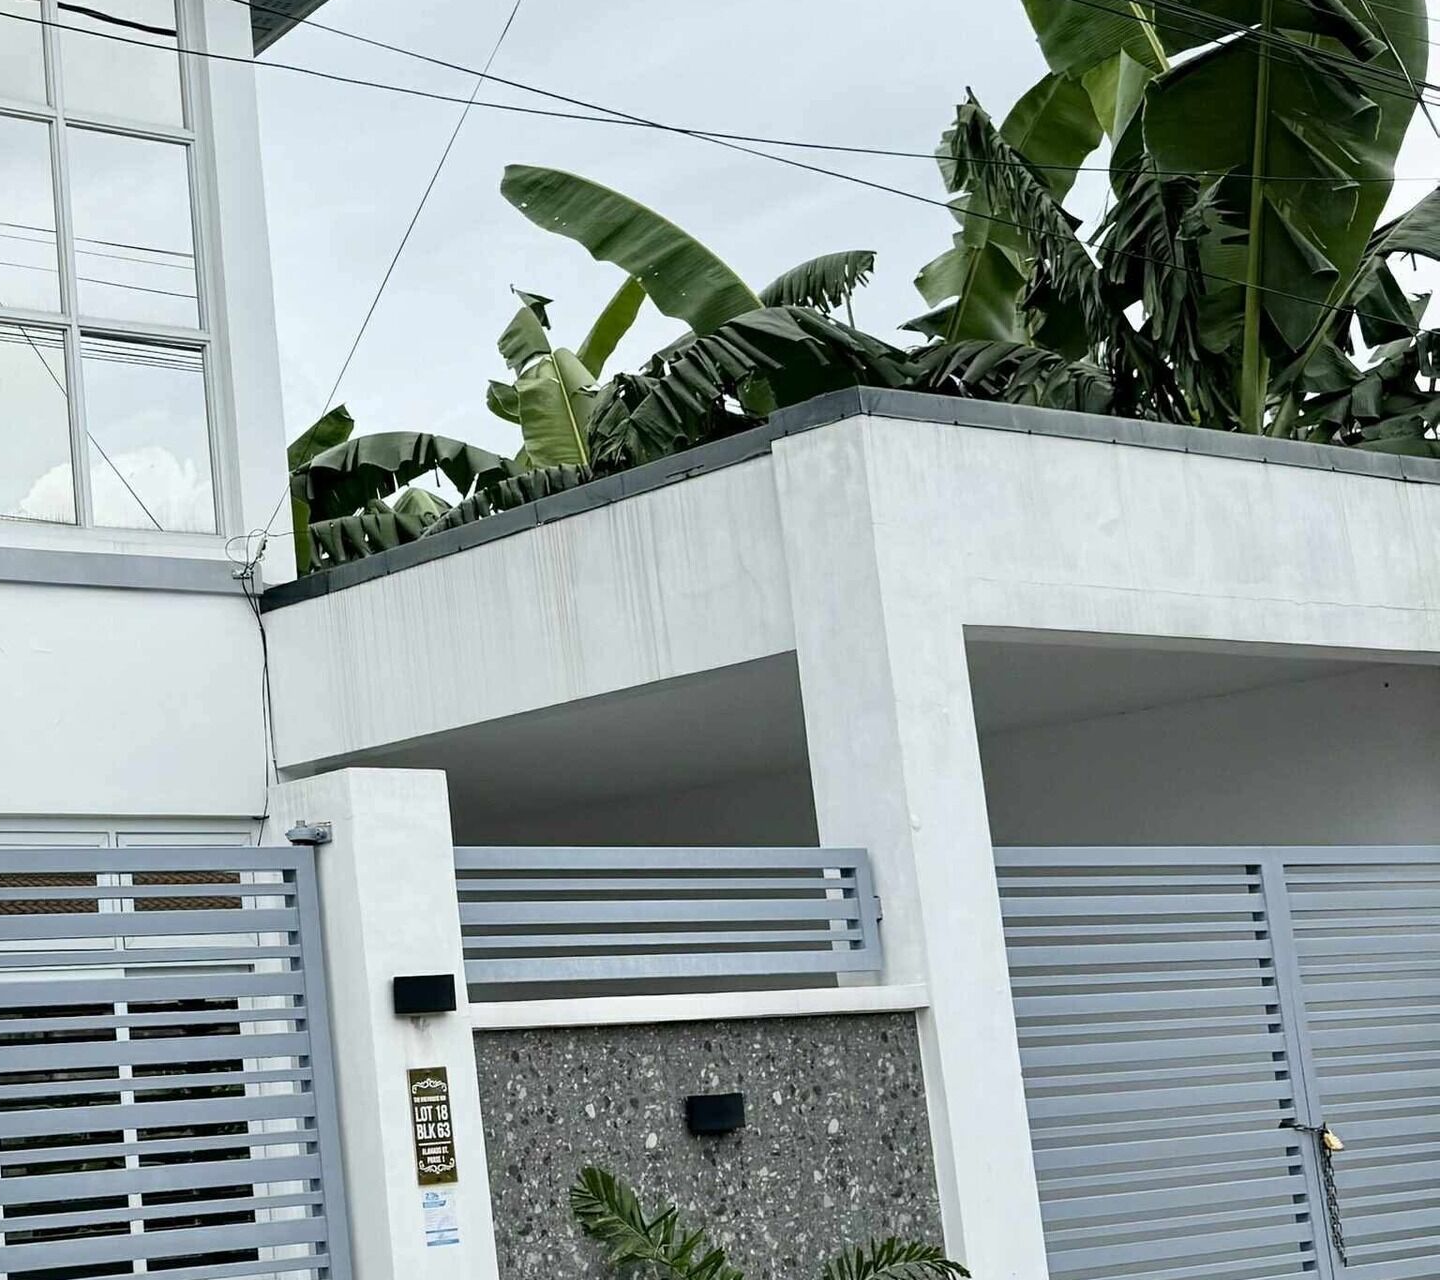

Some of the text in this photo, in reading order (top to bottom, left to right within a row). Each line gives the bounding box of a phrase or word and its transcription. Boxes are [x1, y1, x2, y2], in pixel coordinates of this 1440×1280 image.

[414, 1104, 449, 1122] LOT 18
[416, 1121, 451, 1140] BLK 63
